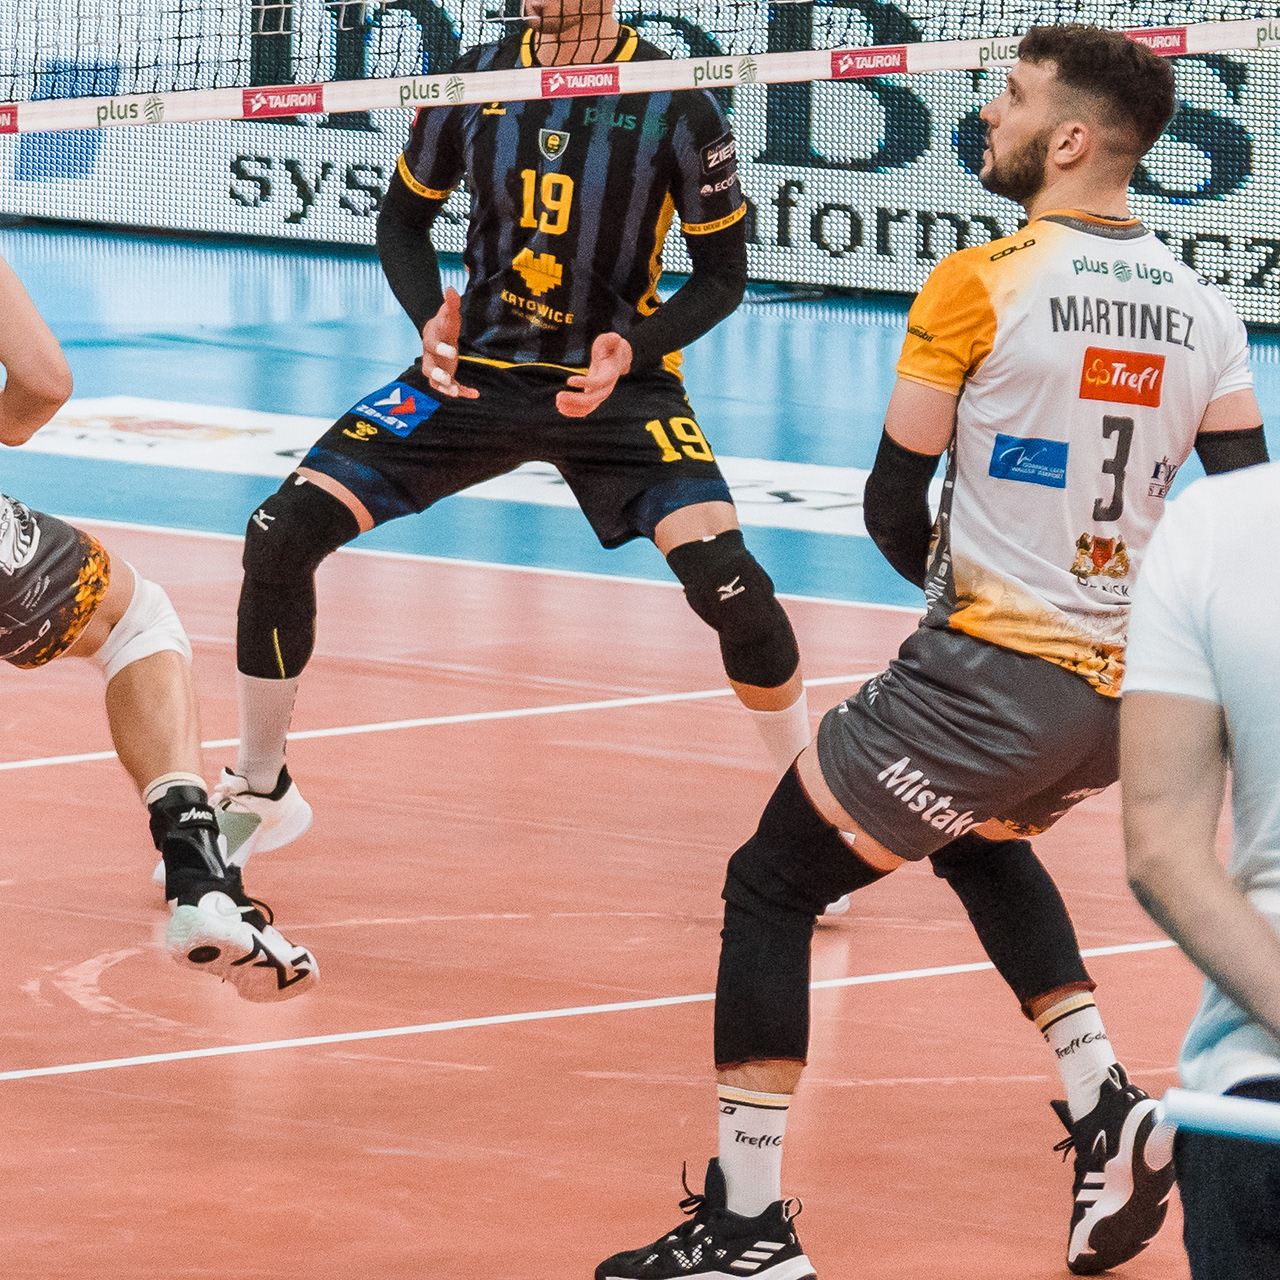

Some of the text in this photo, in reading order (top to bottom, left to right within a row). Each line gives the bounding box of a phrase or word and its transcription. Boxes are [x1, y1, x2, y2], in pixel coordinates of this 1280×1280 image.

[855, 54, 901, 70] TAURON
[979, 41, 1018, 67] plus
[566, 73, 613, 89] TAURON
[694, 60, 733, 86] plus
[268, 93, 318, 109] TAURON
[399, 78, 440, 107] plus
[96, 98, 138, 128] plus
[520, 168, 574, 236] 19
[990, 238, 1036, 262] COLO
[1073, 255, 1110, 278] plus
[1135, 262, 1175, 286] liga
[500, 288, 575, 325] KATOWICE
[1050, 295, 1196, 353] MARTINEZ
[1111, 362, 1160, 393] Trefl
[645, 416, 715, 463] 19
[1092, 414, 1135, 522] 3
